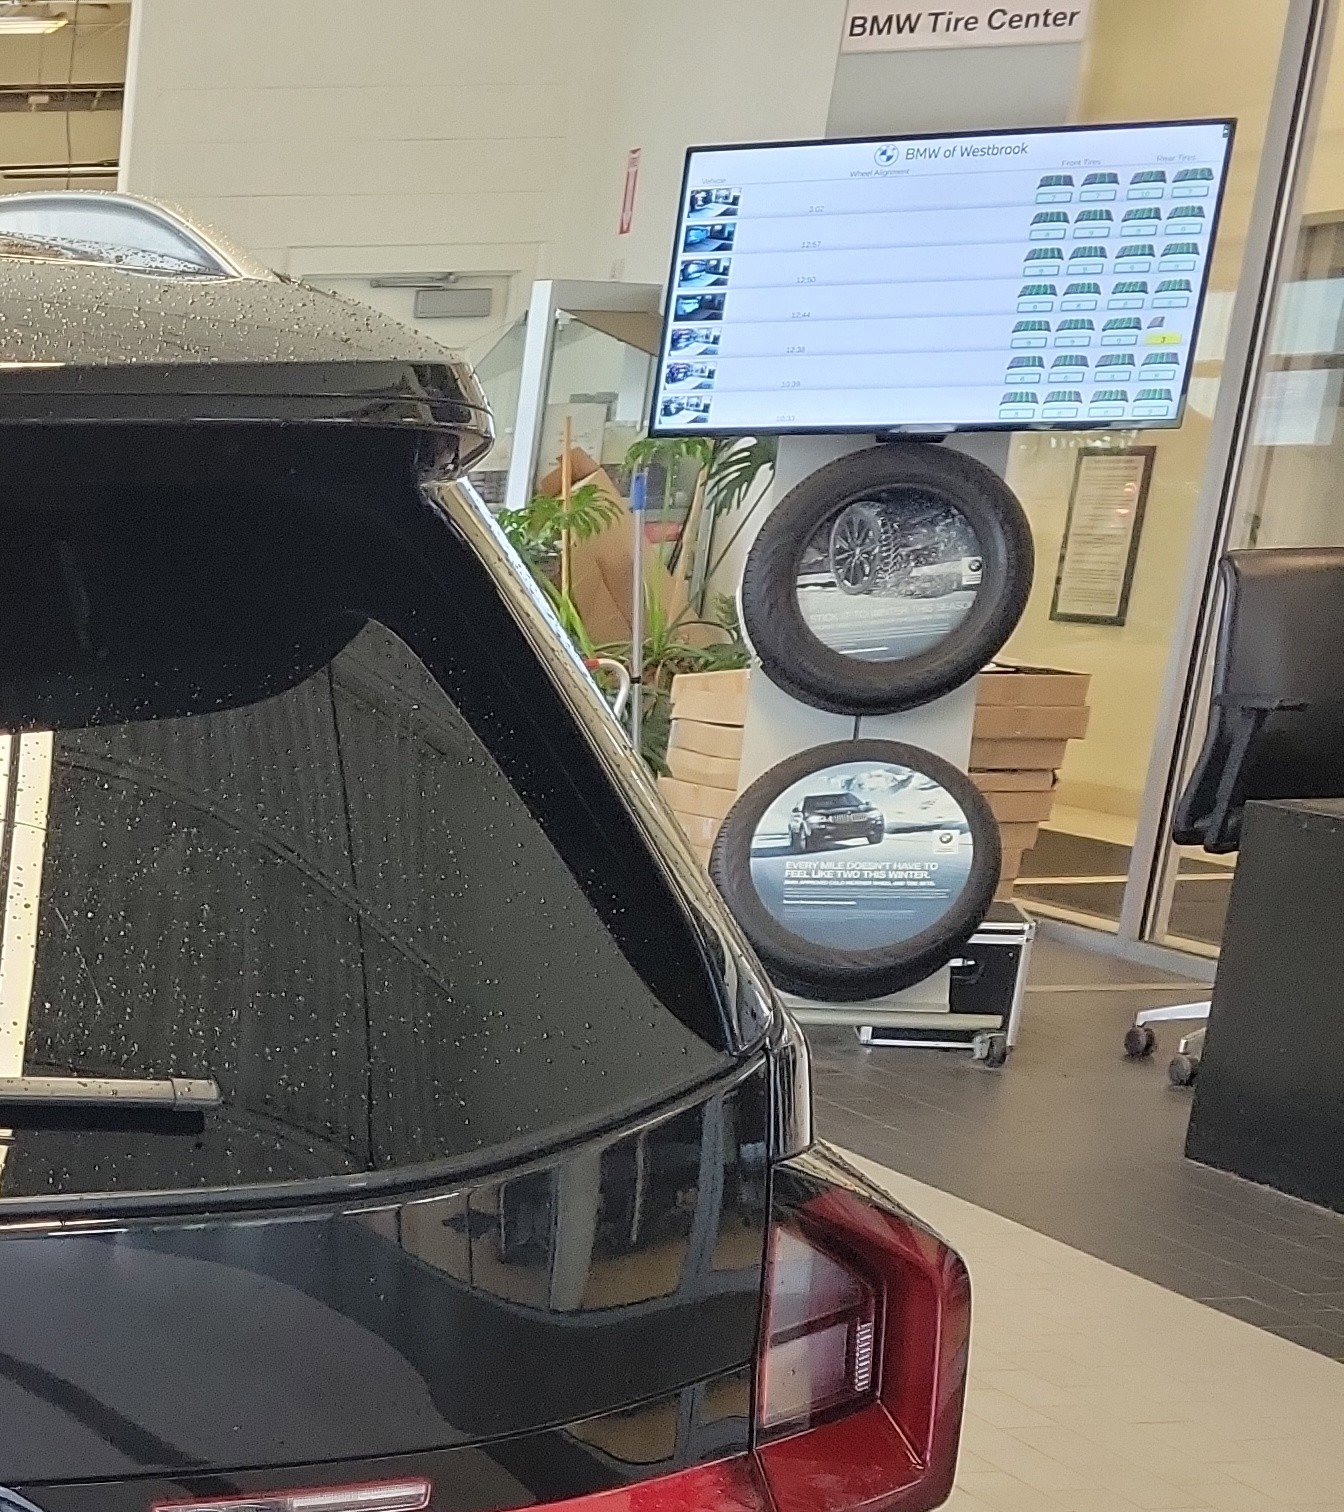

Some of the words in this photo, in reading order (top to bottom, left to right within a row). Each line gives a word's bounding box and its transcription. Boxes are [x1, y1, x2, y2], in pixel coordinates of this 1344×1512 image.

[849, 13, 922, 38] BMW
[928, 11, 979, 34] Tire
[987, 8, 1081, 31] Center
[905, 146, 941, 161] BMW
[943, 145, 959, 159] of
[960, 142, 1029, 158] Westbrook
[785, 861, 818, 870] EVERY
[820, 861, 845, 870] MILE
[846, 861, 891, 870] DOESN'T
[893, 861, 922, 870] HAVE
[924, 861, 938, 870] TO
[784, 870, 810, 878] FEEL
[811, 870, 834, 878] LIKE
[836, 870, 860, 878] TWO
[863, 870, 887, 878] THIS
